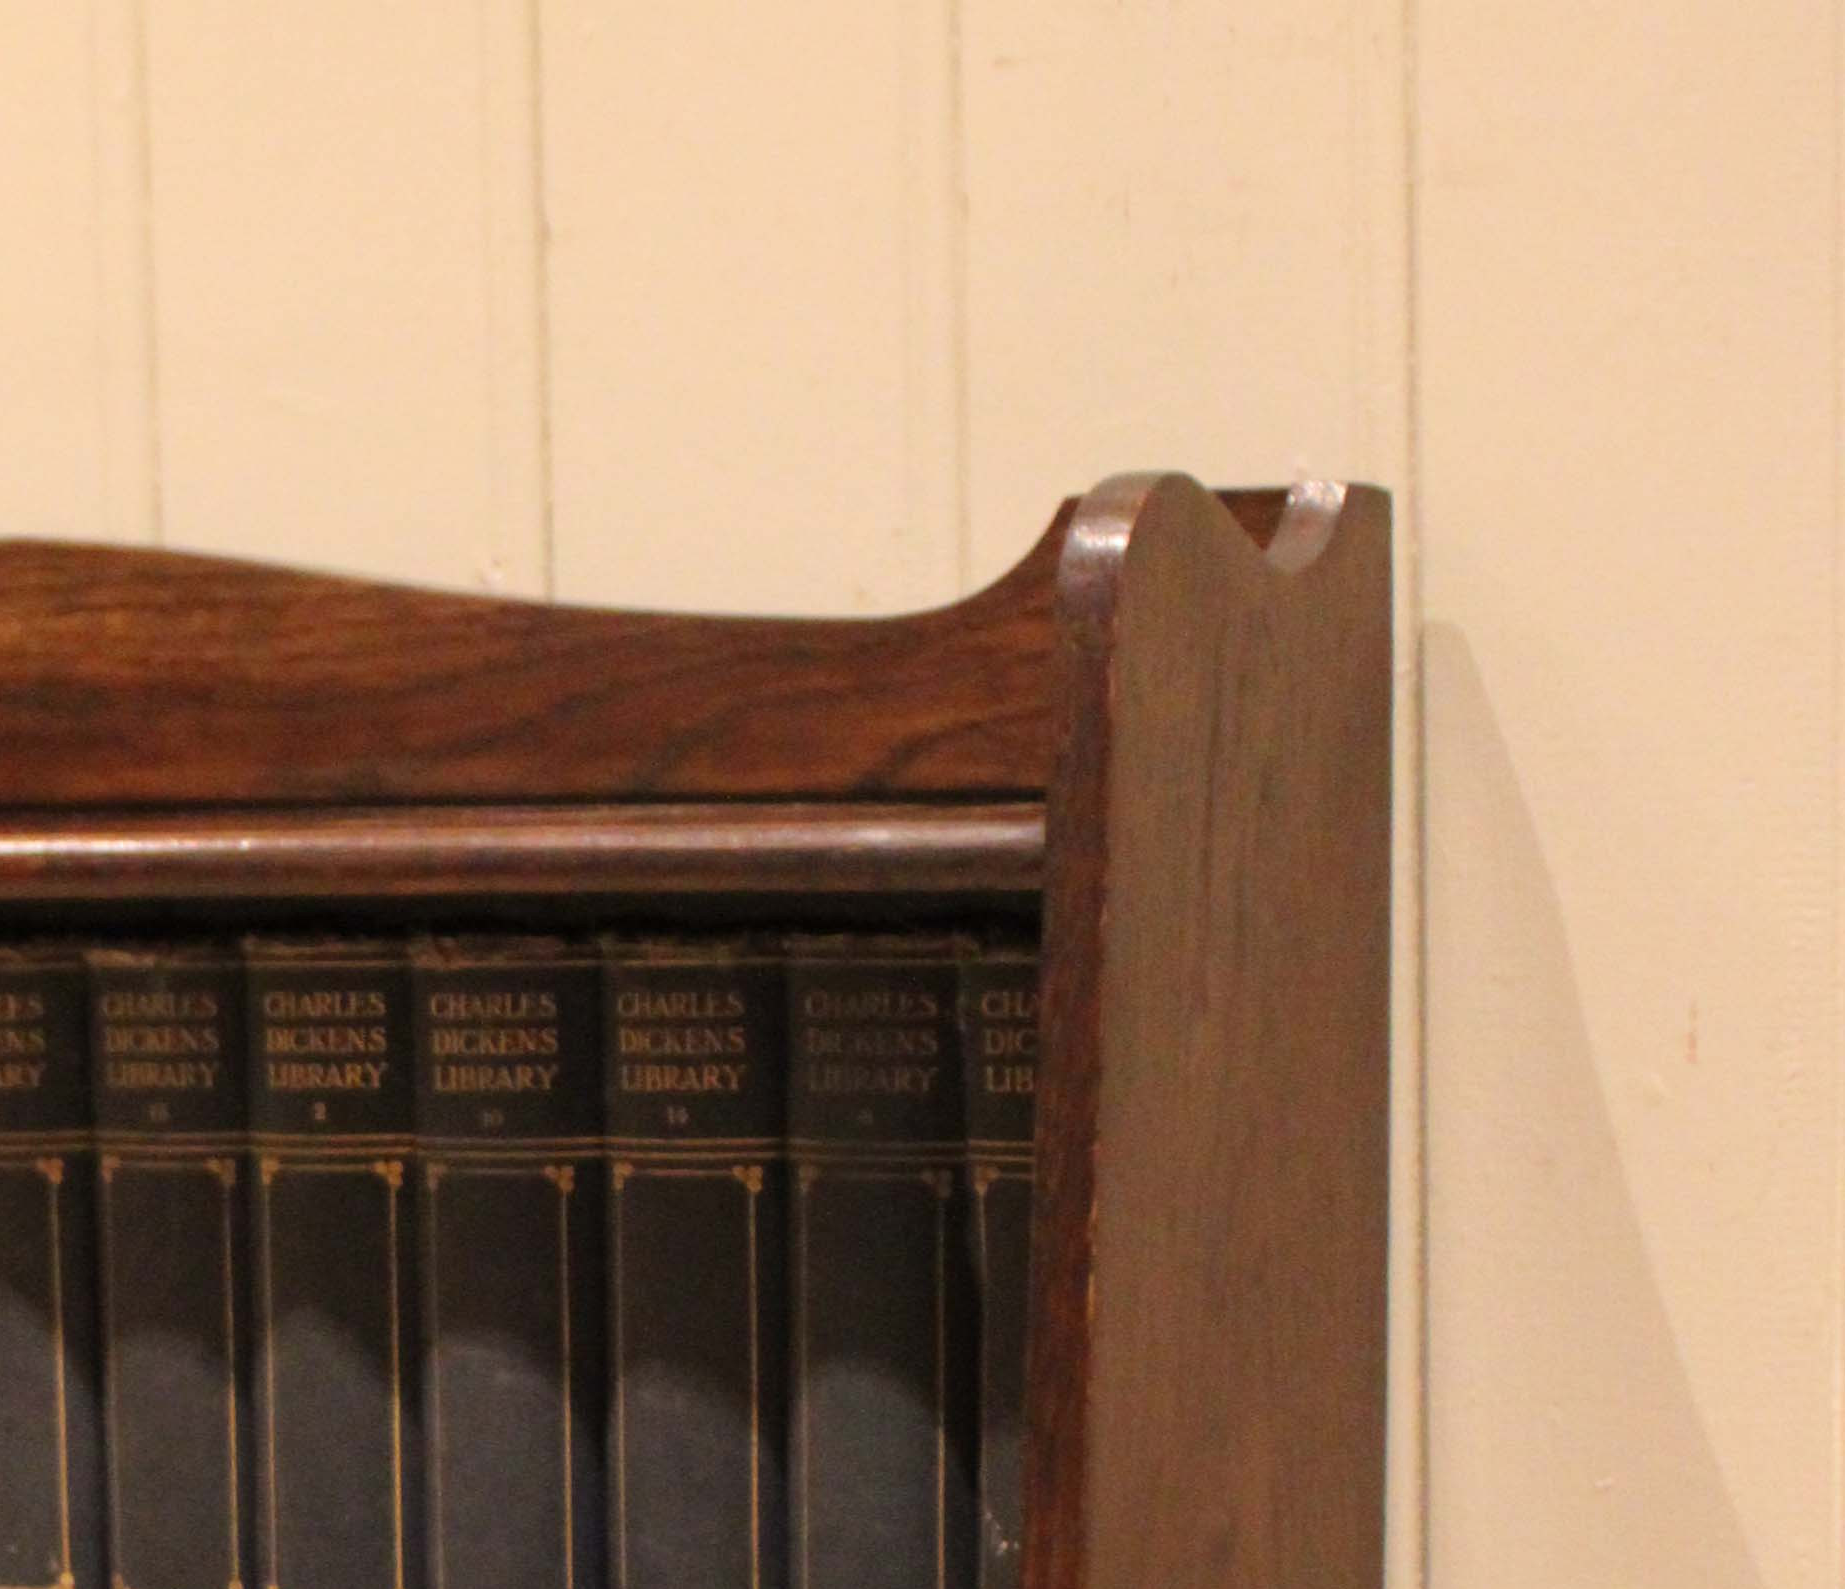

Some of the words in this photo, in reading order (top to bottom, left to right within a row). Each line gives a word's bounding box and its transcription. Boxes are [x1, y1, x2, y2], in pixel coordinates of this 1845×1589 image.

[264, 991, 386, 1018] CHARLES
[429, 992, 557, 1018] CHARLES
[617, 992, 745, 1018] CHARLES
[266, 1026, 387, 1054] DICKENS
[431, 1028, 558, 1056] DICKENS
[619, 1027, 745, 1056] DICKENS
[267, 1061, 389, 1090] LIBRARY
[433, 1064, 558, 1092] LIBRARY
[621, 1065, 746, 1092] LIBRARY
